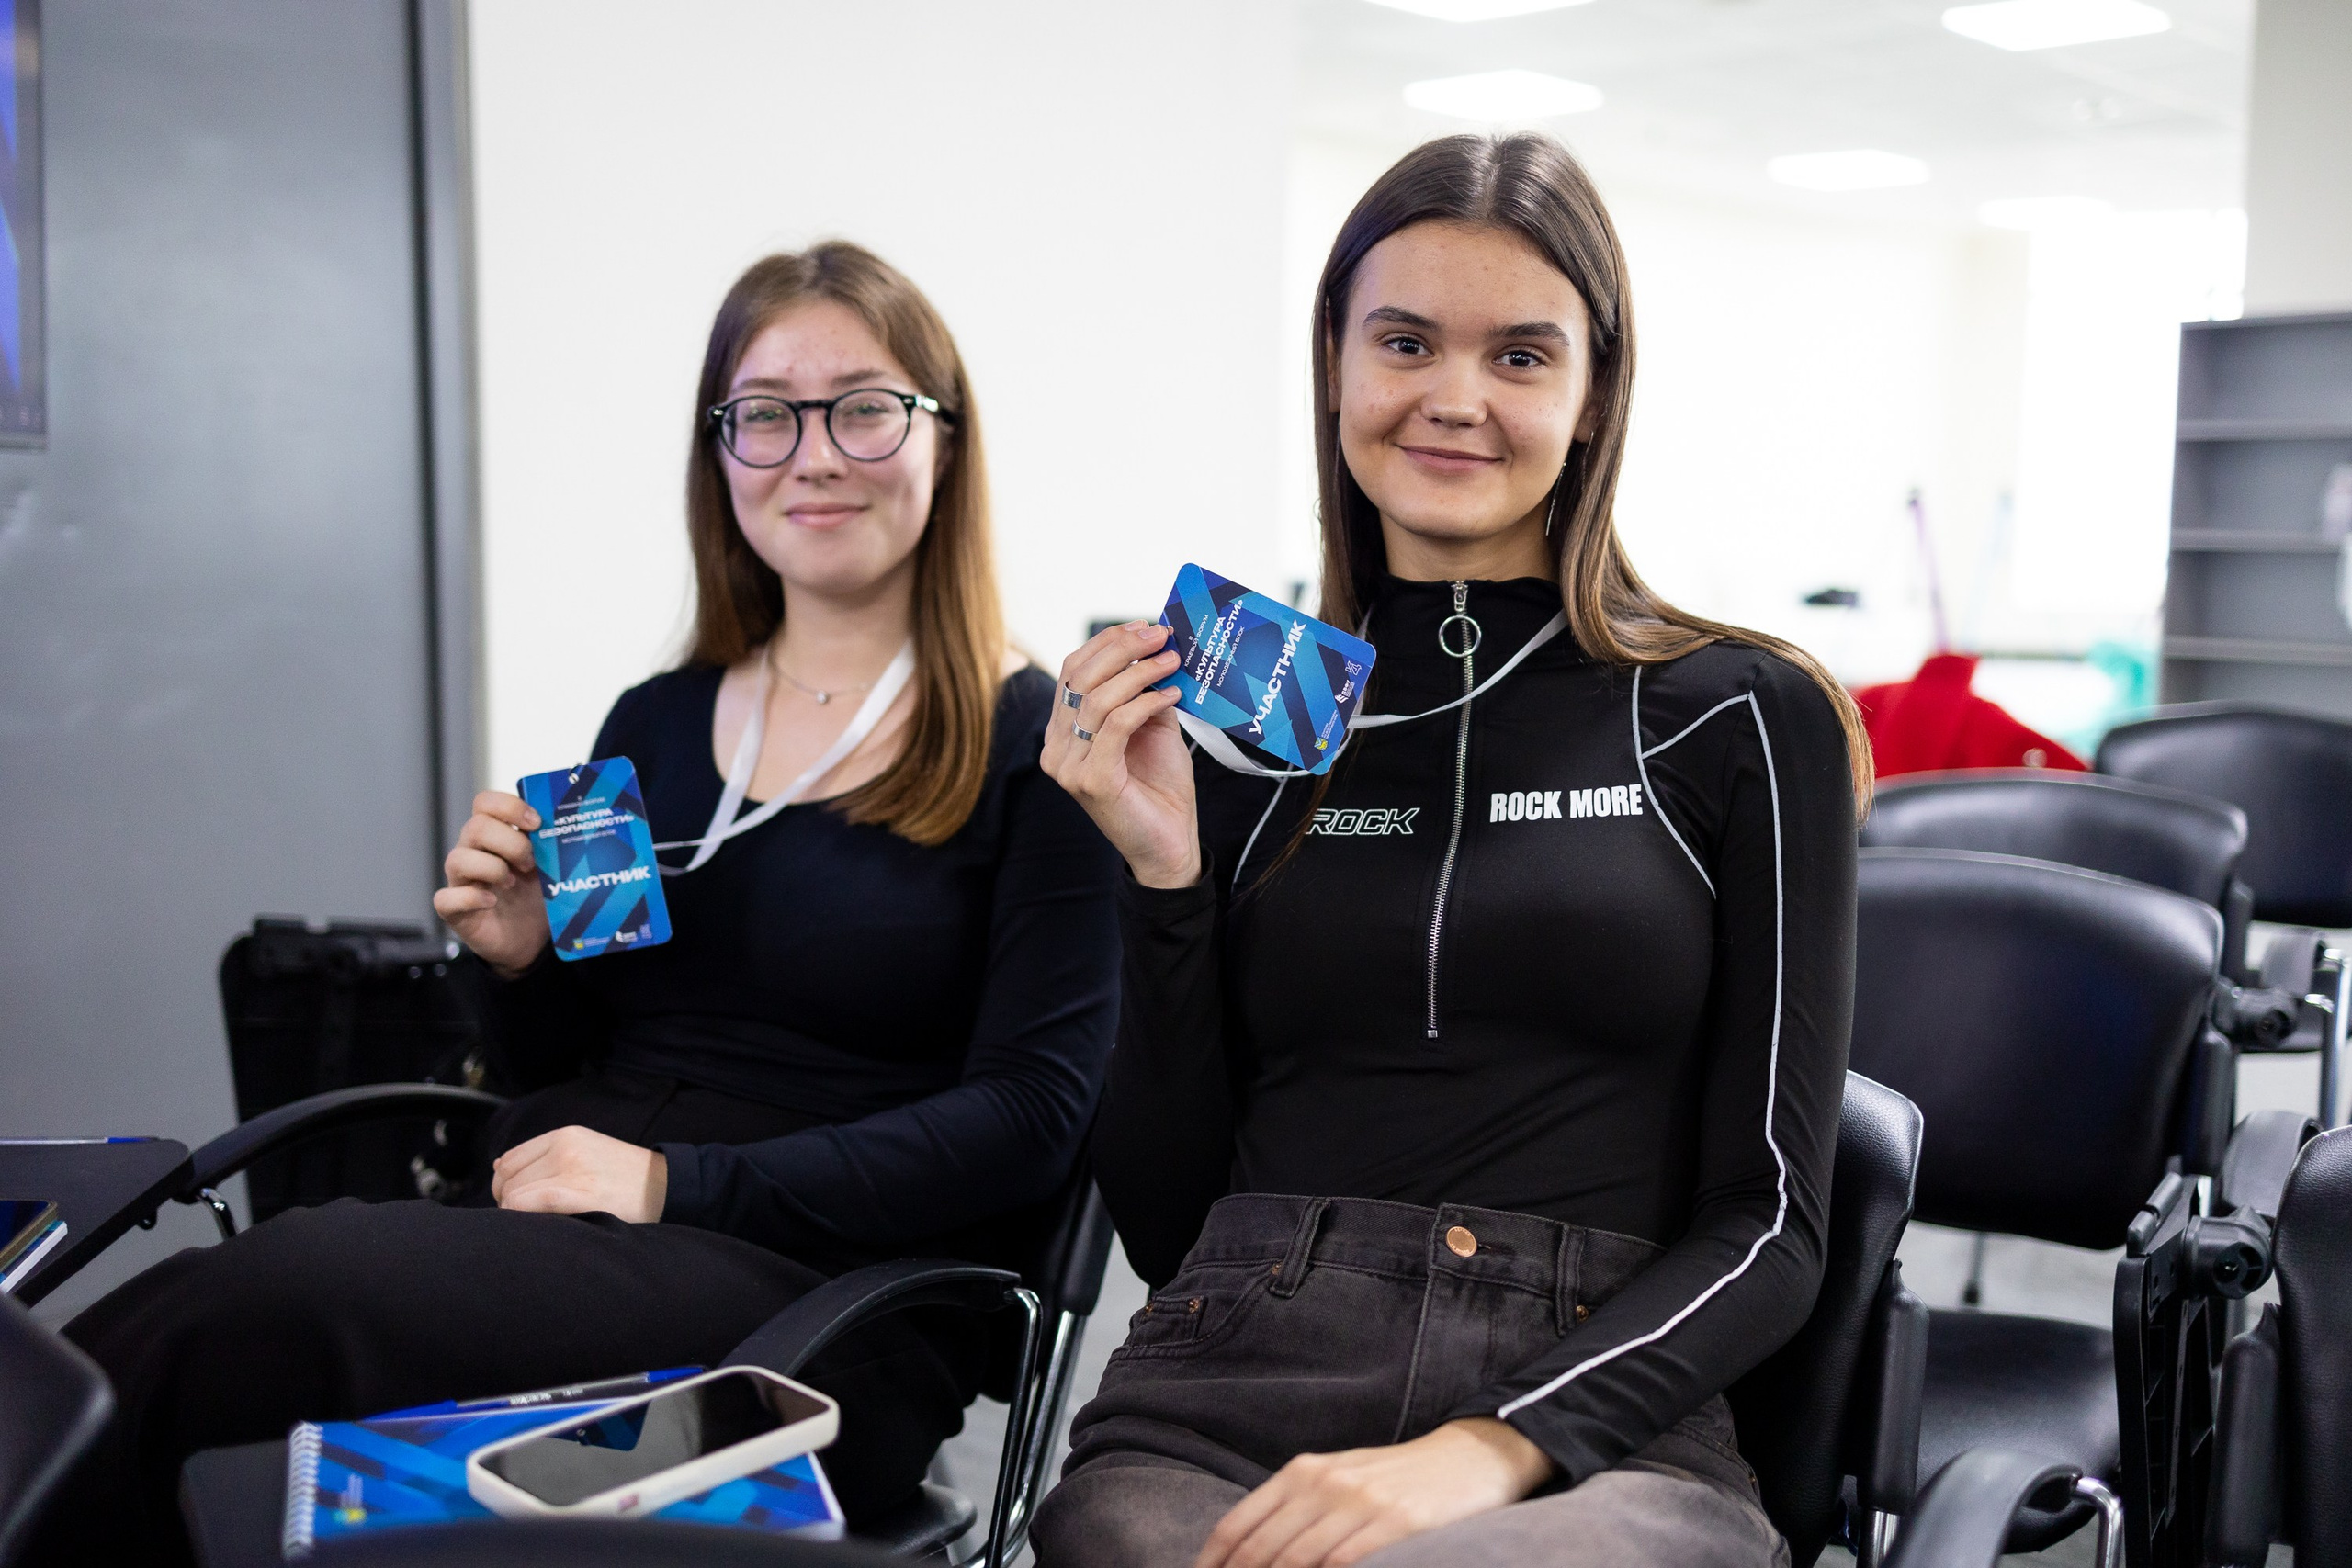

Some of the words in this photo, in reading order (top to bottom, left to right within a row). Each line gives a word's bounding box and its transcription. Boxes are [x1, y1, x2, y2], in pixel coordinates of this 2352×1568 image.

[1184, 637, 1199, 668] КРАЕВОЙ
[1196, 614, 1209, 638] ФОРУМ
[1194, 599, 1243, 705] БЕЗОПАСНОСТИ»
[1195, 616, 1227, 682] «КУЛЬТУРА
[1235, 626, 1245, 644] БЛОК
[1248, 619, 1306, 735] УЧАСТНИК
[554, 807, 614, 826] «КУЛЬТУРА
[1305, 807, 1420, 835] ROCK
[1489, 791, 1562, 823] ROCK
[1569, 784, 1643, 818] MORE
[538, 814, 635, 839] БЕЗОПАСНОСТИ»
[548, 865, 651, 897] УЧАСТНИК
